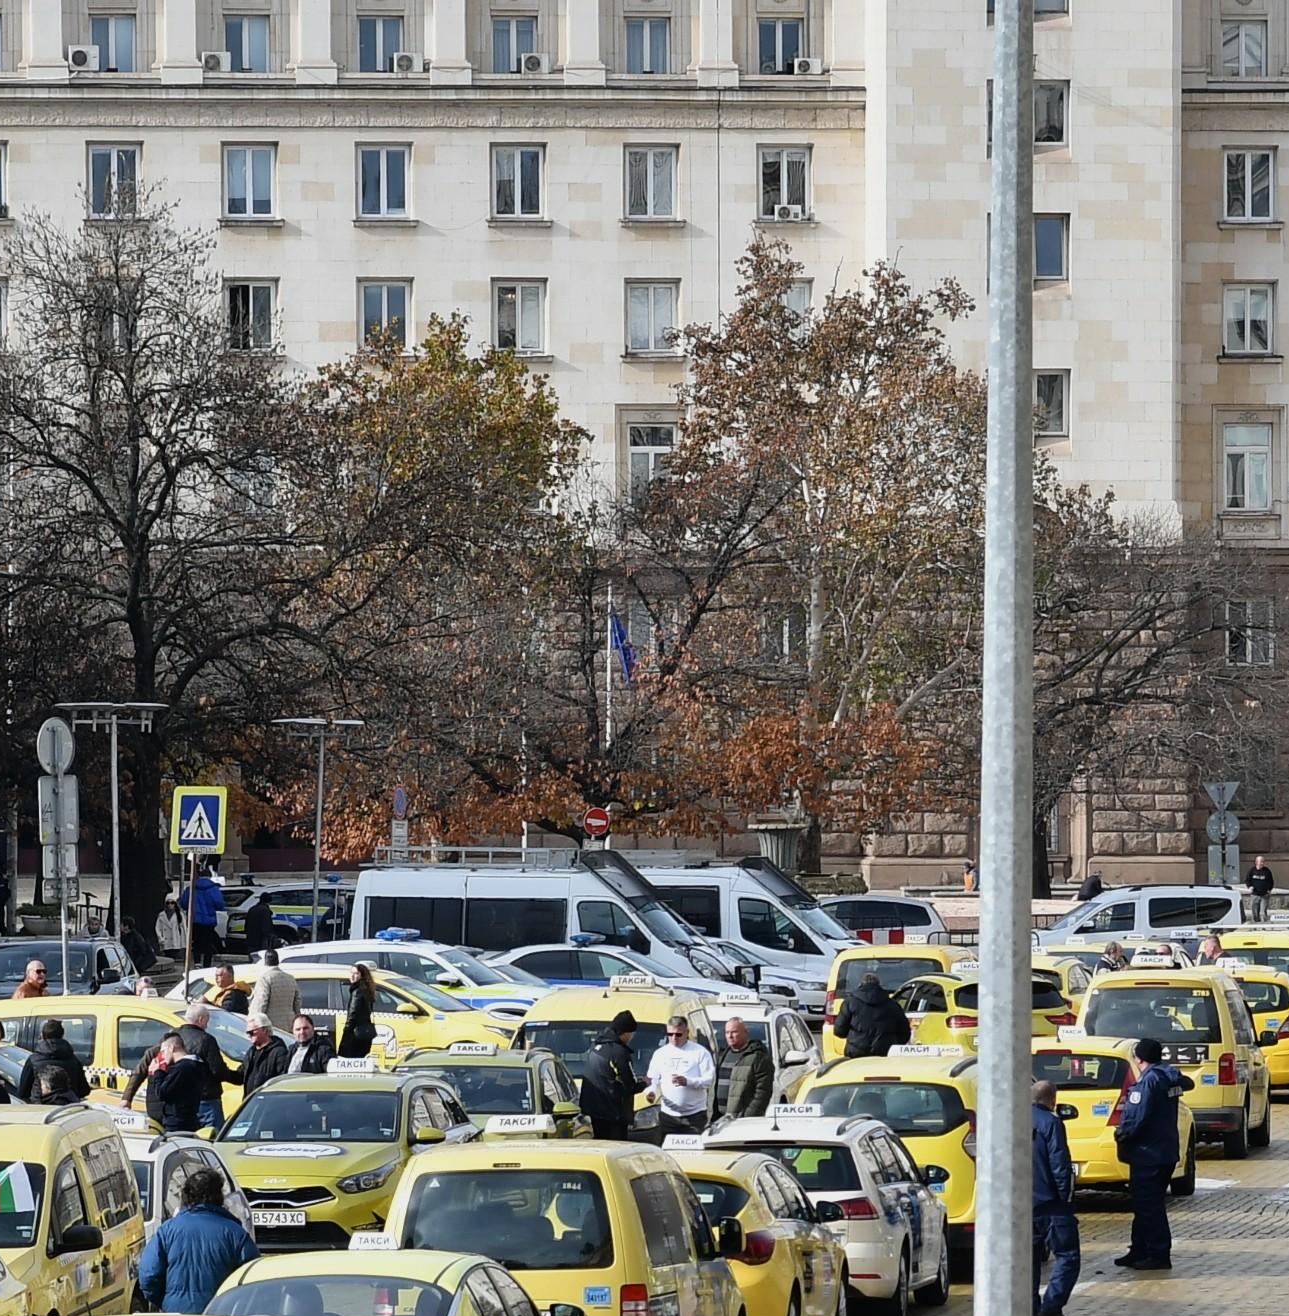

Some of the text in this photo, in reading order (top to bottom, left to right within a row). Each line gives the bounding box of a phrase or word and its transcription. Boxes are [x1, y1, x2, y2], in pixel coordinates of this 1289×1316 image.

[617, 976, 646, 984] ТАКСИ
[335, 1060, 367, 1068] ТАКСИ
[114, 1117, 135, 1125] КСИ
[499, 1117, 535, 1126] ТАКСИ
[261, 1213, 287, 1224] 5743
[359, 1236, 390, 1245] ТАКСИ
